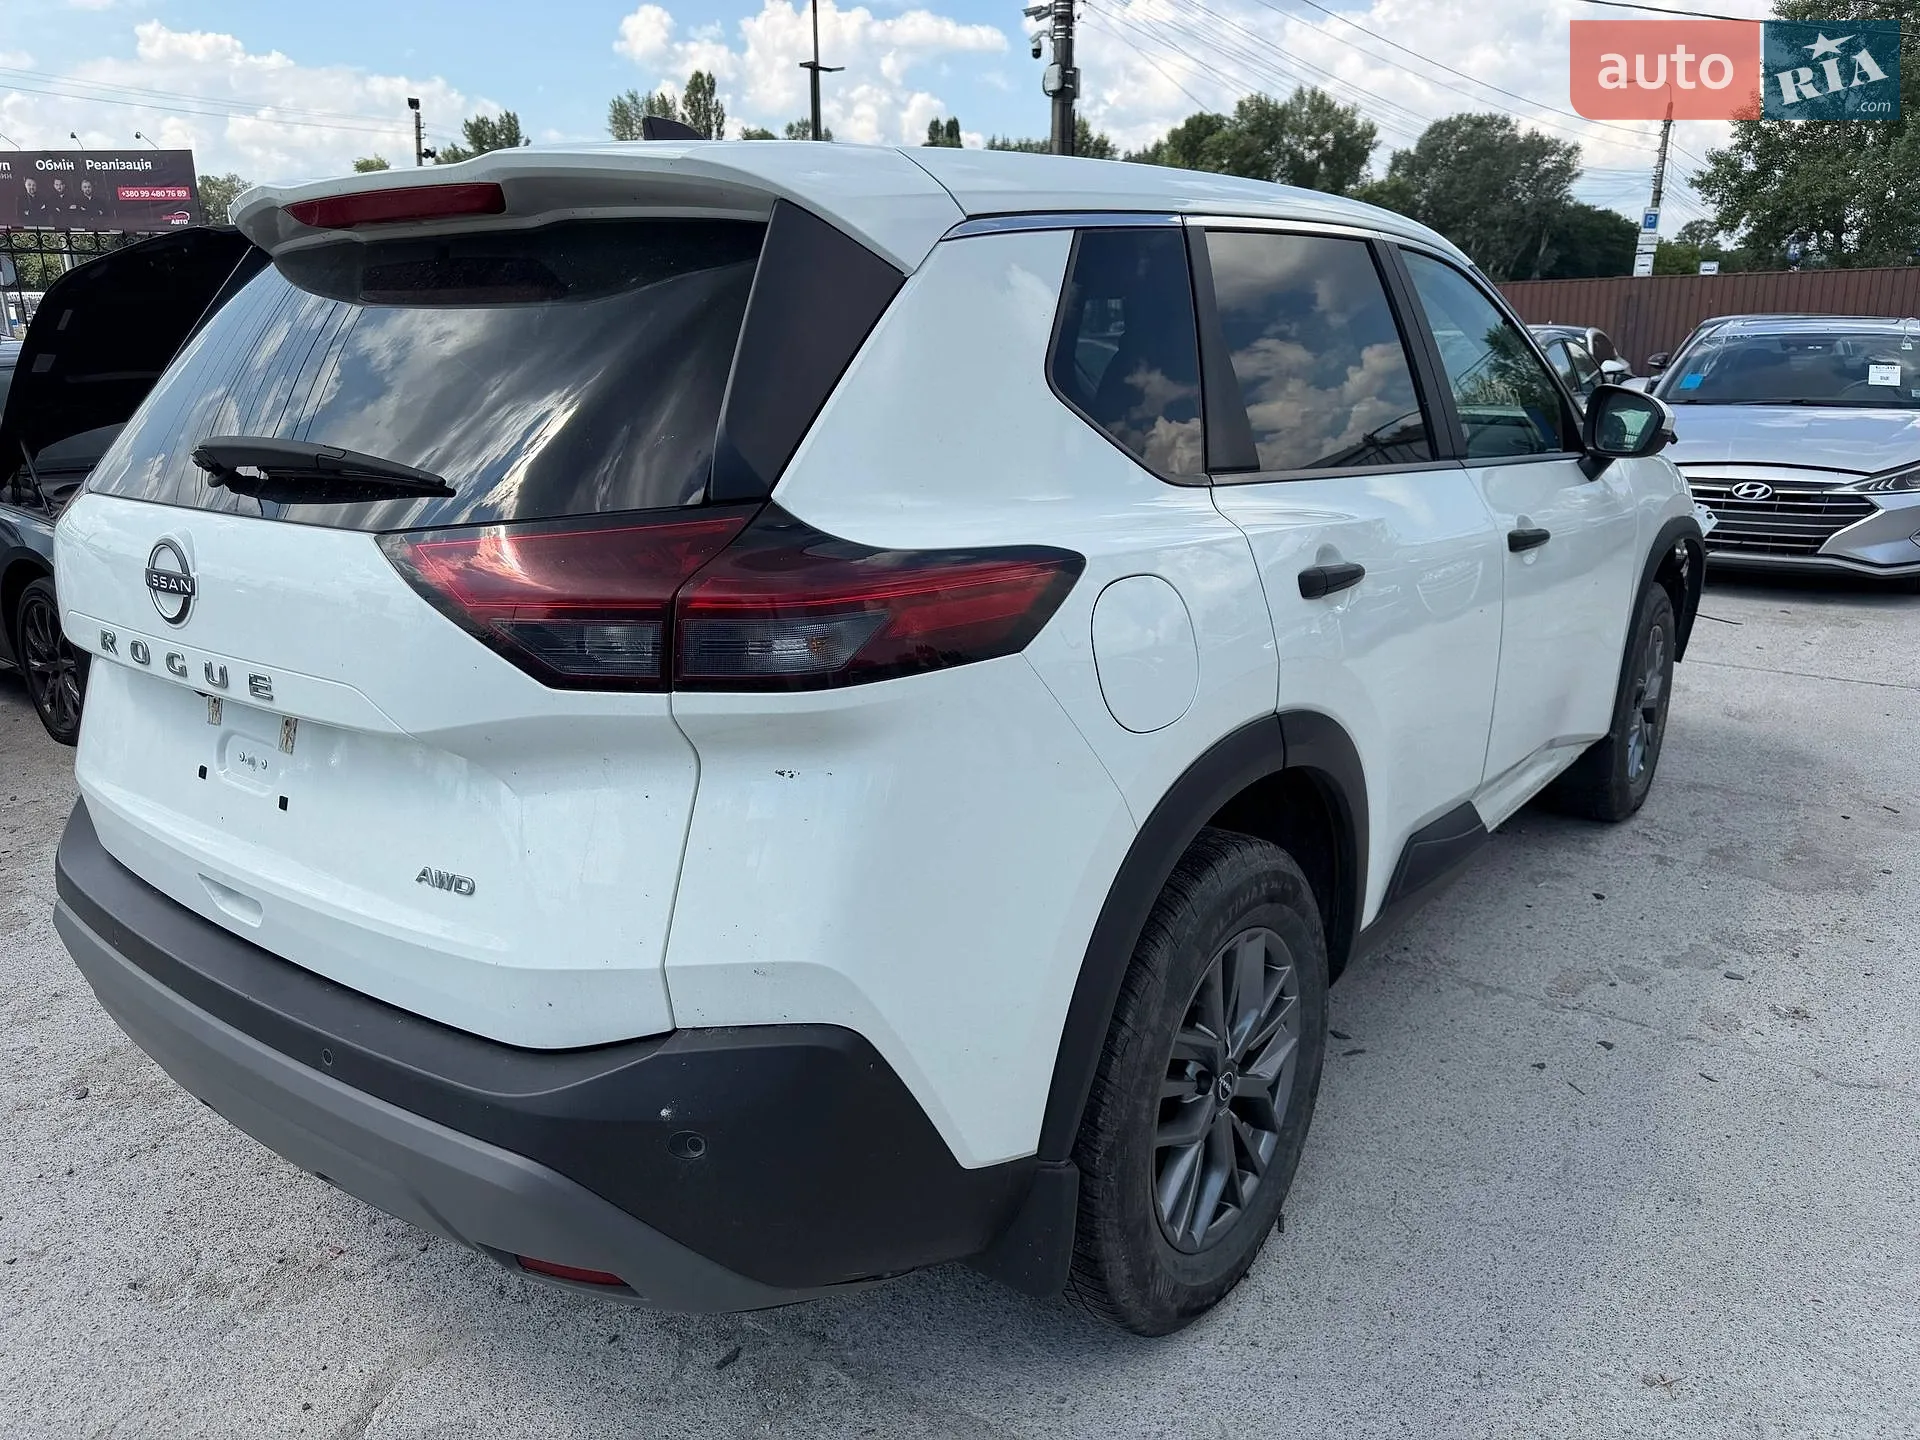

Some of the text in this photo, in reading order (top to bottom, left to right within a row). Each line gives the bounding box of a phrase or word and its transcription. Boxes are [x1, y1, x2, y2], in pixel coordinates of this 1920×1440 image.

[35, 158, 75, 171] Обмін
[85, 158, 152, 172] Реалізація
[121, 190, 139, 198] +380
[140, 190, 150, 198] 99
[150, 190, 166, 198] 480
[1646, 214, 1656, 227] P
[100, 629, 274, 702] ROGUE
[415, 866, 476, 896] AWD
